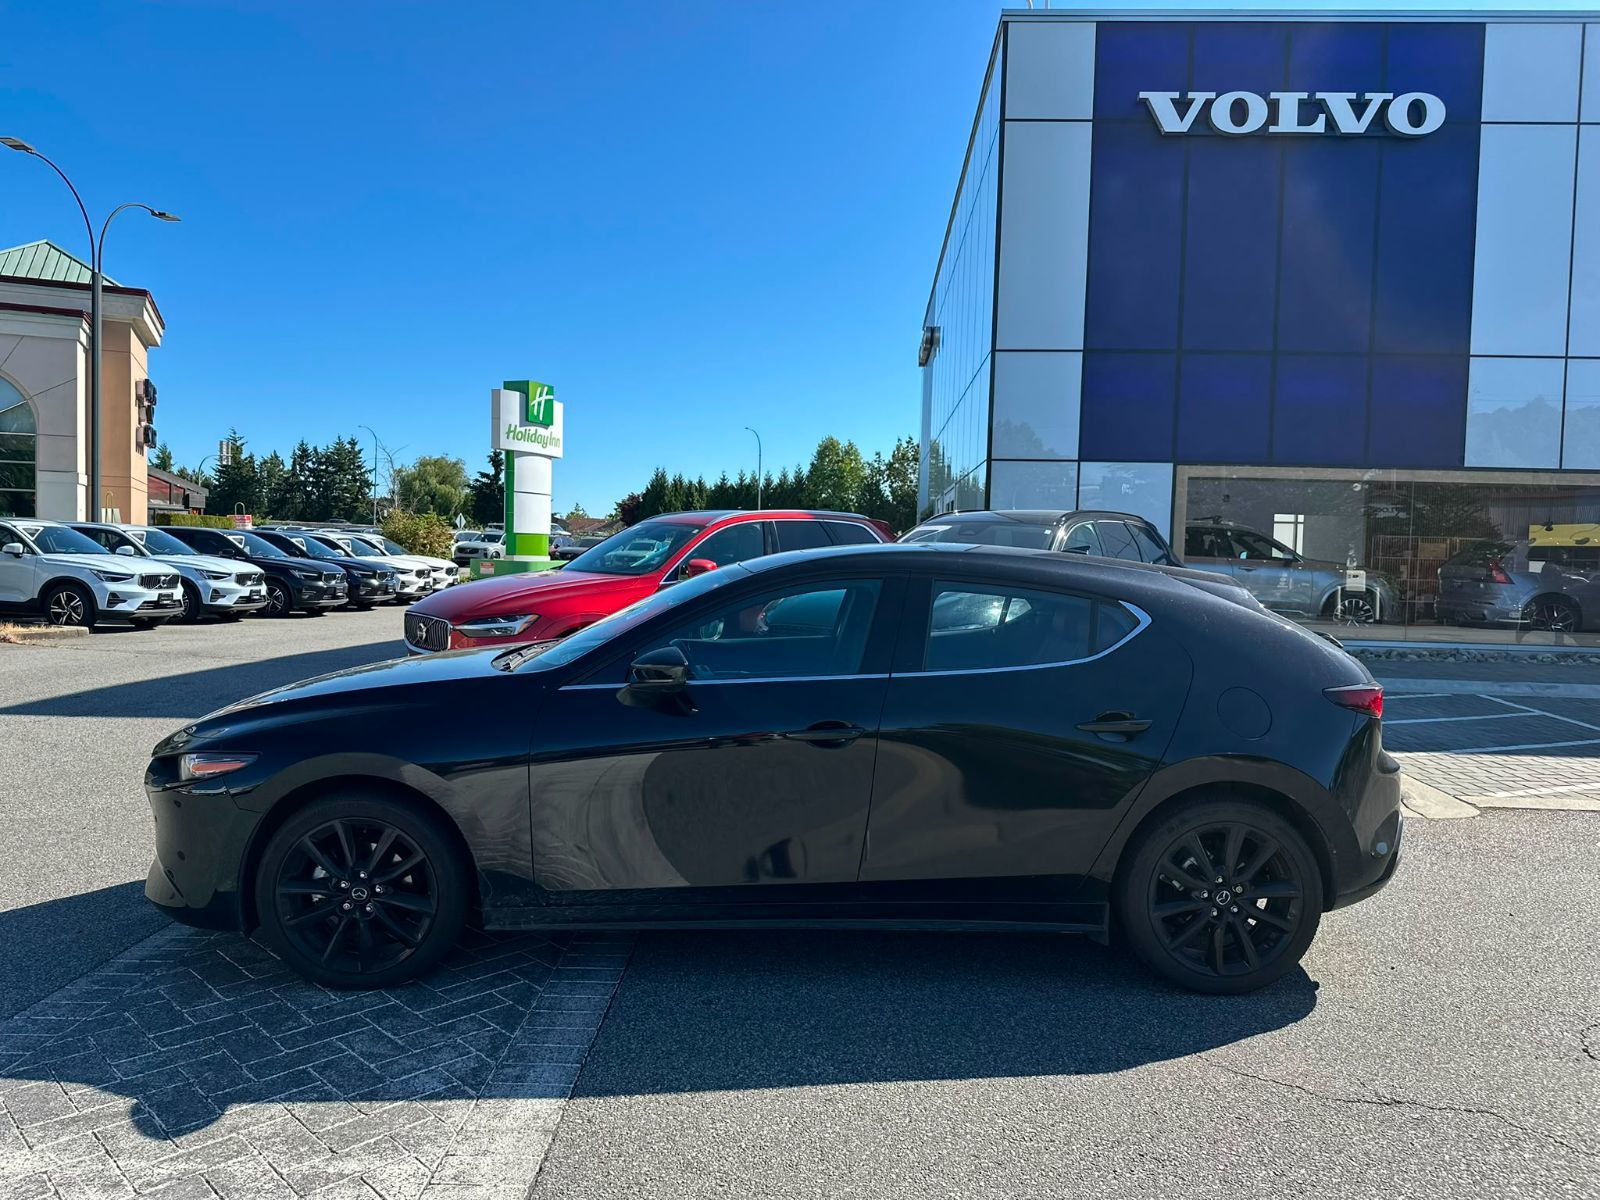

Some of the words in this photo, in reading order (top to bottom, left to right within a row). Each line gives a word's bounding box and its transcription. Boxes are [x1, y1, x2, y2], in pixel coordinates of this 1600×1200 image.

[1138, 90, 1447, 136] VOLVO
[506, 424, 549, 448] Holiday
[549, 431, 561, 448] Inn
